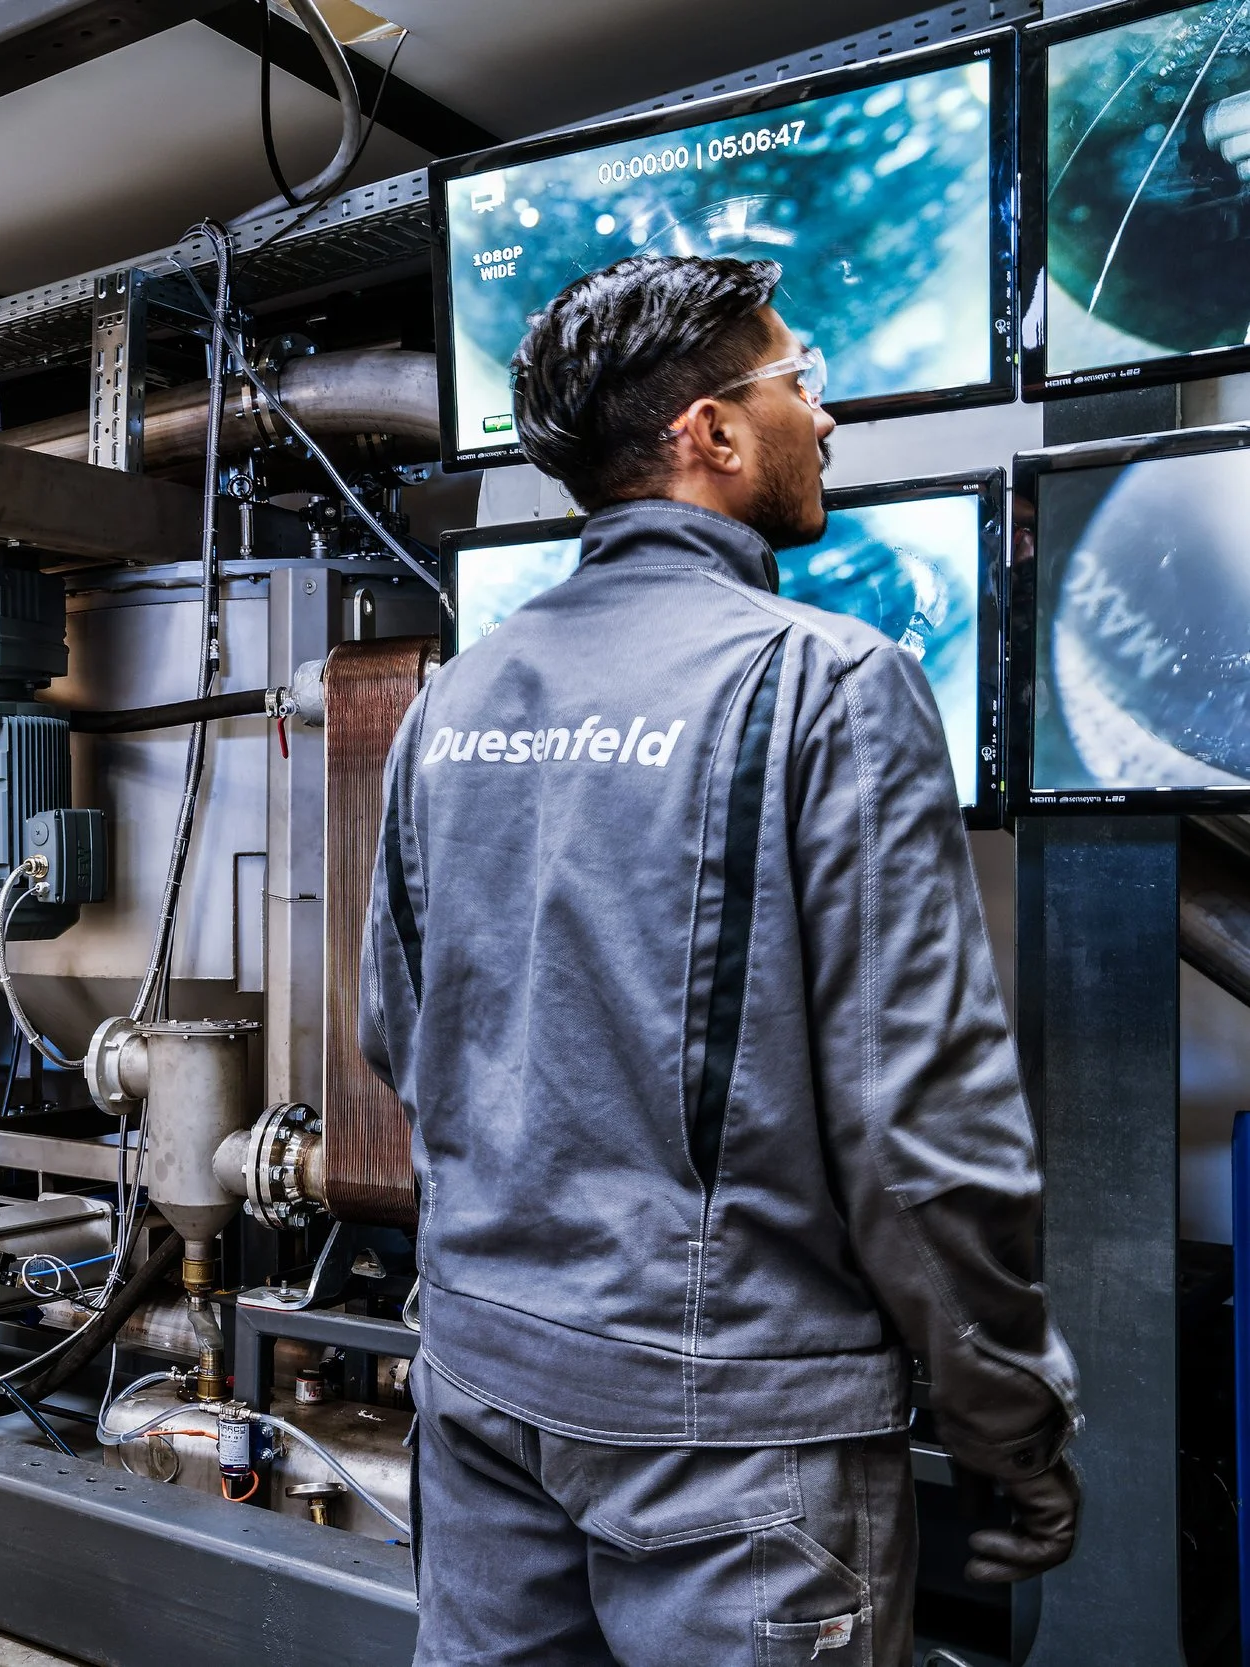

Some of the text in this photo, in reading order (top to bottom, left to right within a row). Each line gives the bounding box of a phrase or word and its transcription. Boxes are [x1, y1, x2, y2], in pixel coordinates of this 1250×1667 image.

[598, 147, 689, 185] 00:00:00
[708, 120, 805, 162] 05:06:47
[472, 245, 524, 267] 1080P
[480, 264, 517, 281] WIDE
[422, 715, 686, 767] Duesenfeld
